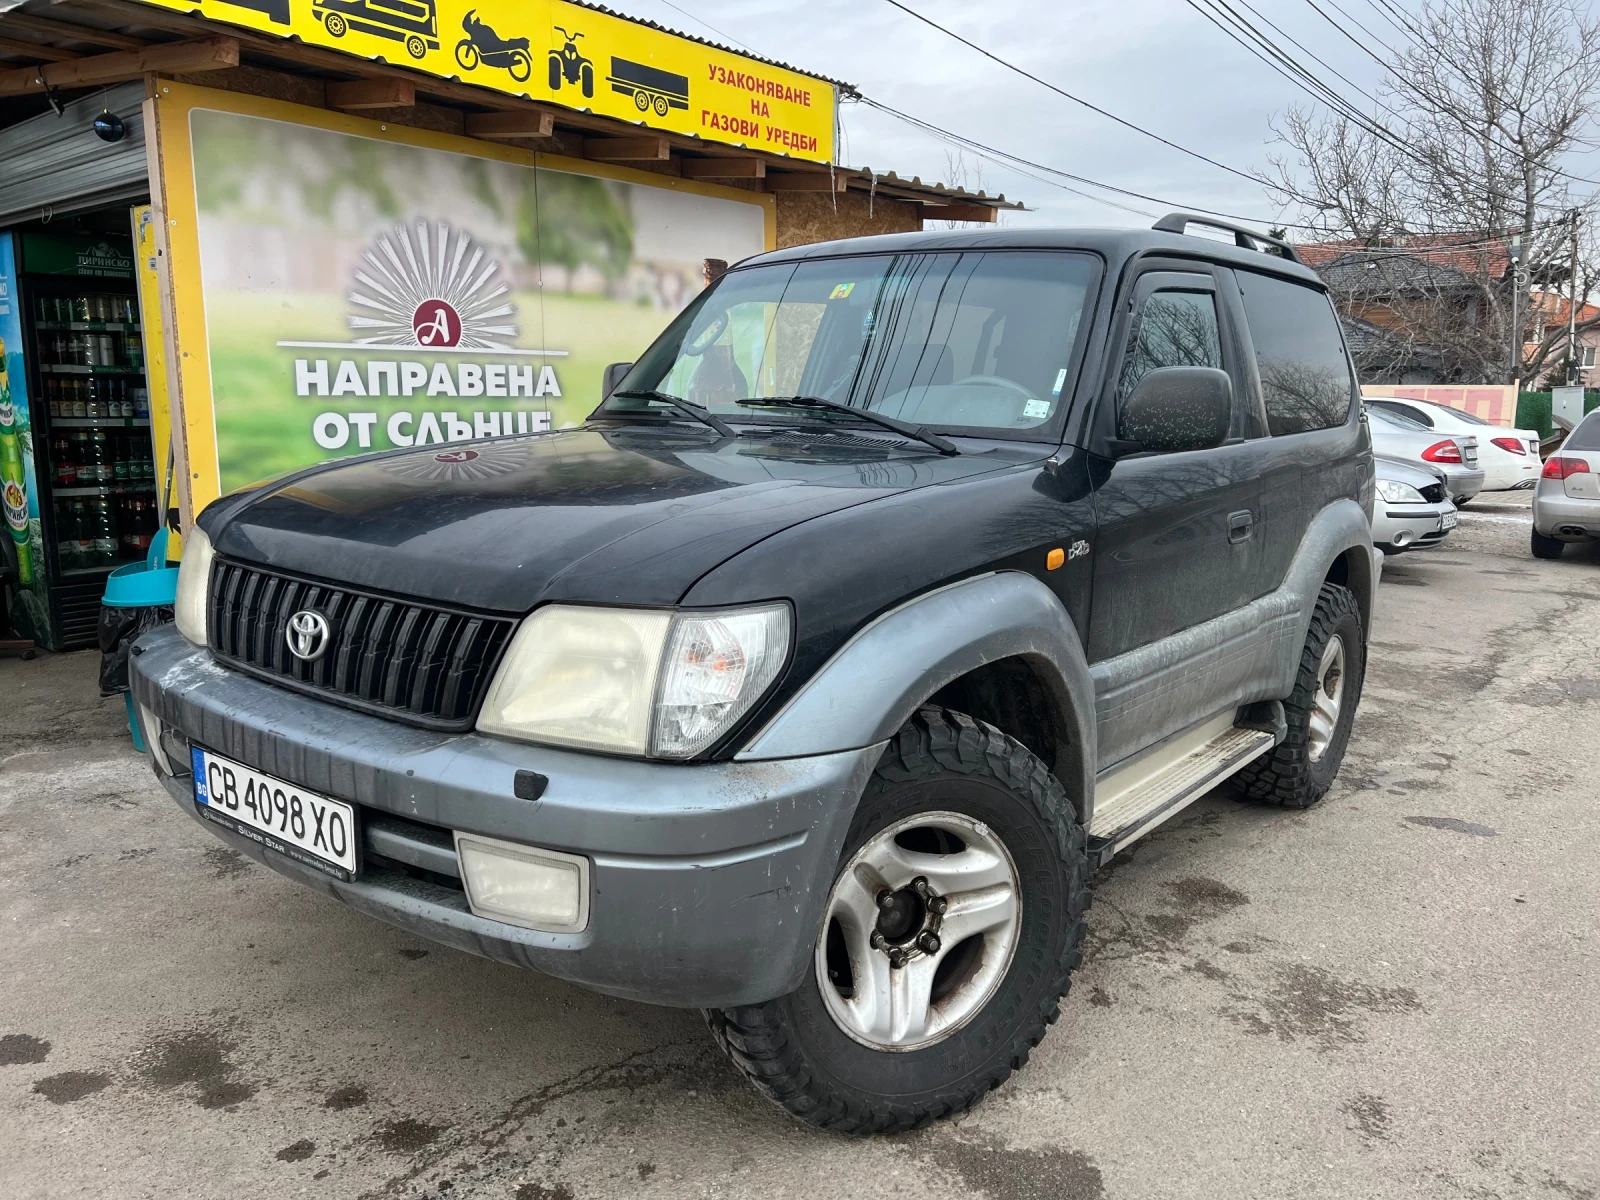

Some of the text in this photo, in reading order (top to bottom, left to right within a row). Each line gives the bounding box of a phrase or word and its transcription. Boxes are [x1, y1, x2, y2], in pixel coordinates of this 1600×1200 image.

[708, 63, 811, 107] УЗАКОНЯВАНЕ
[750, 98, 770, 118] НА
[701, 109, 817, 152] ГАЗОВИ УРЕДБИ
[295, 359, 562, 397] НАПРАВЕНА
[313, 411, 377, 449] ОТ
[197, 782, 208, 797] BG
[208, 761, 347, 858] CB 4098 XO
[238, 825, 264, 843] SILVER
[265, 837, 285, 853] STAR
